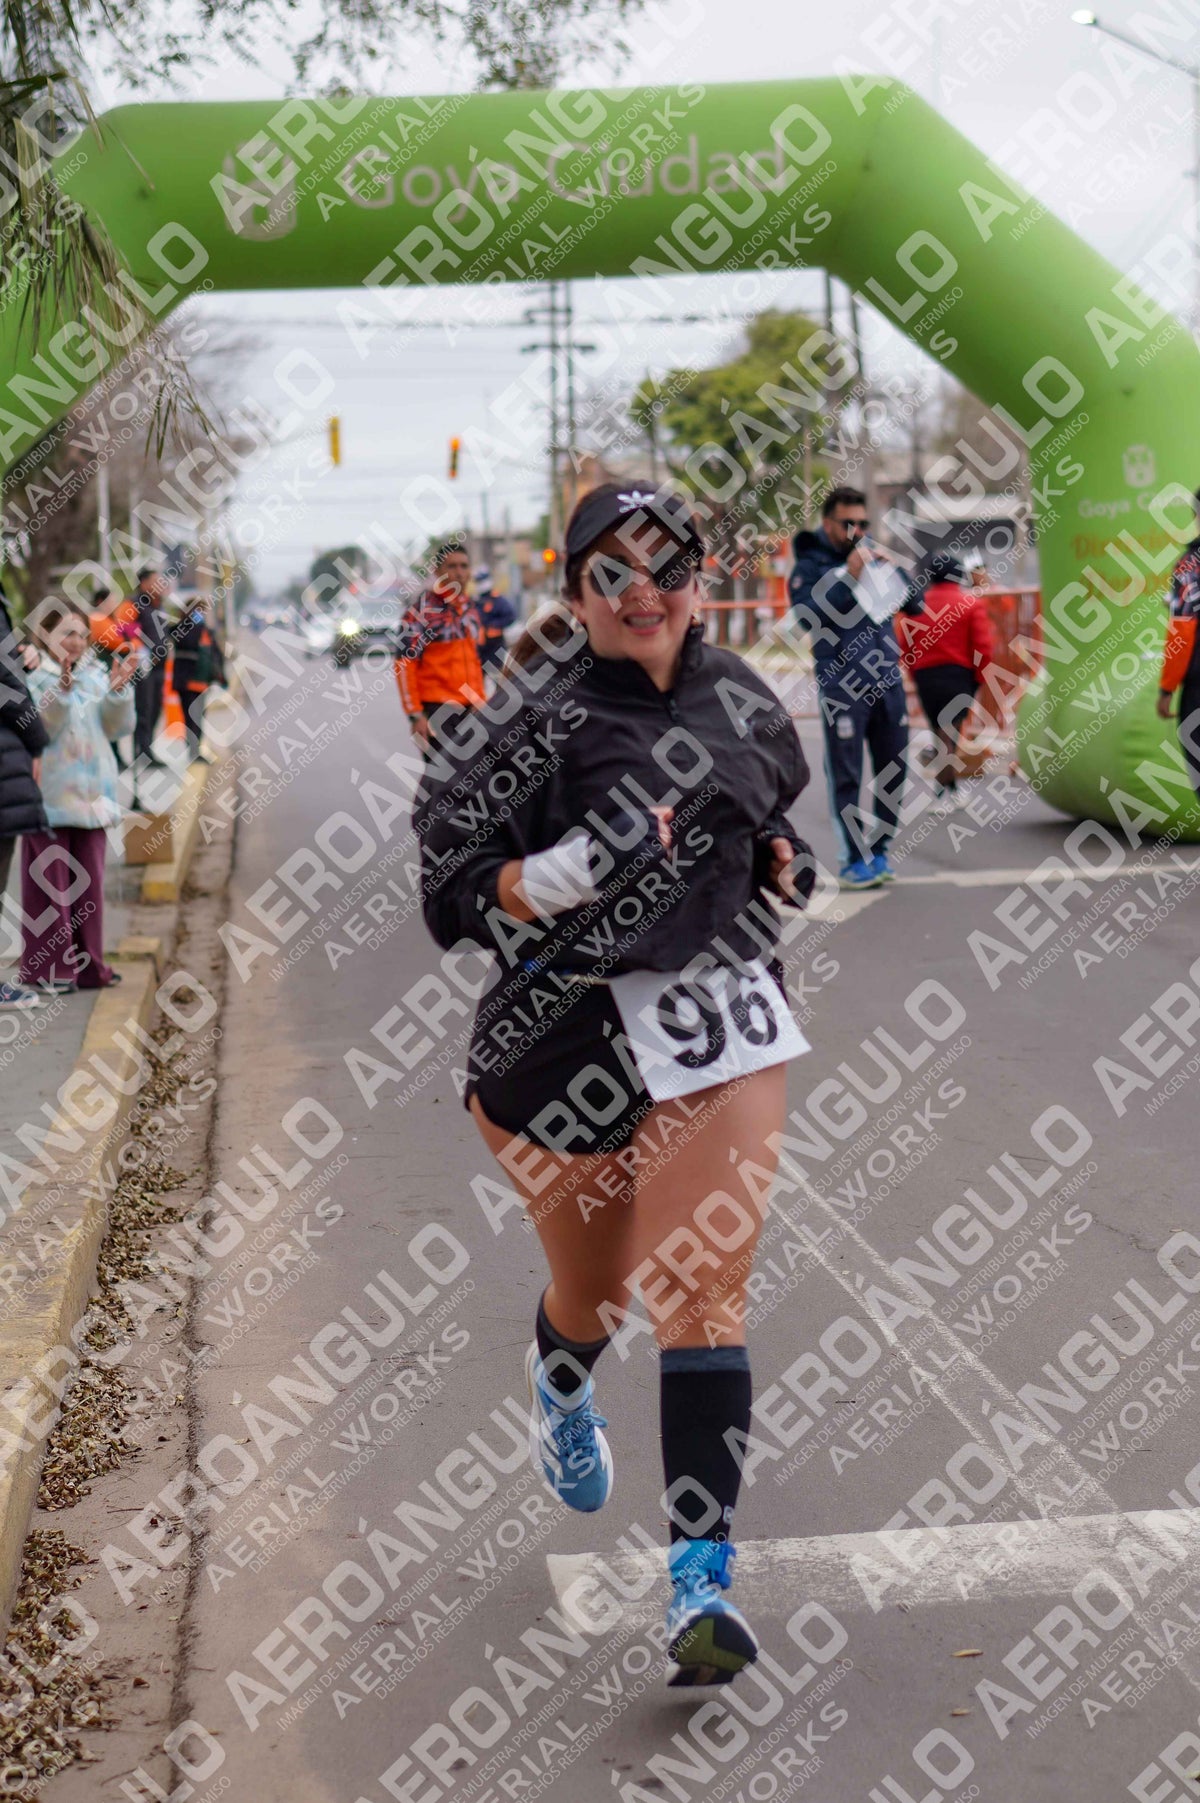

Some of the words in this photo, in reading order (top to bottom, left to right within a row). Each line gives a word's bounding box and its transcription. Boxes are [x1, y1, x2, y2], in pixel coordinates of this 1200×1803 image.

[343, 147, 520, 223] Goya
[546, 130, 787, 202] Ciudad
[1078, 499, 1132, 520] Goya
[657, 969, 778, 1069] 96
